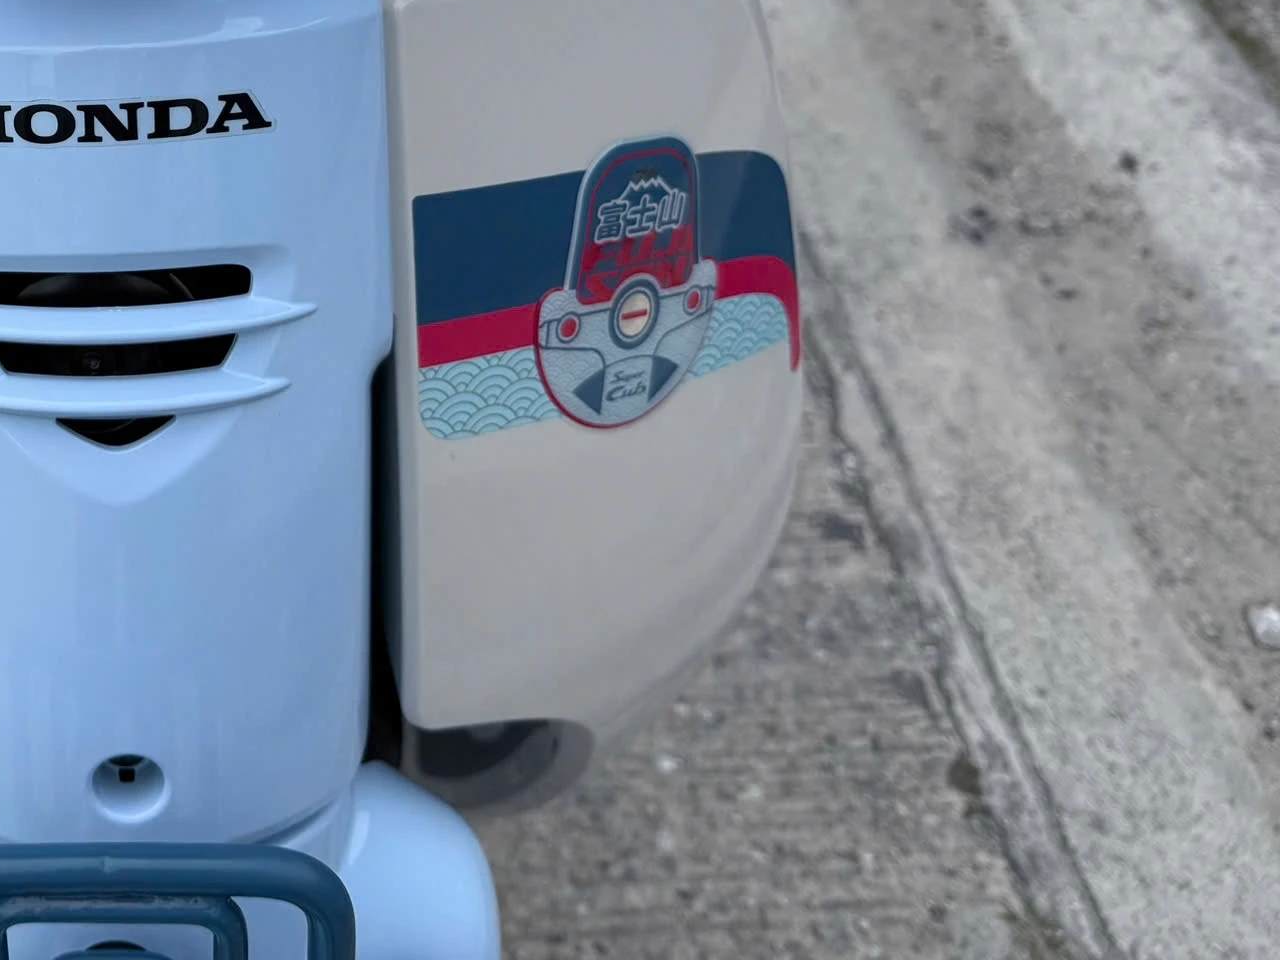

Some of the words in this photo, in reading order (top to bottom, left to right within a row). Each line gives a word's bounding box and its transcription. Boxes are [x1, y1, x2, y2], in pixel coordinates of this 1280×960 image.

[593, 188, 687, 244] 富士山
[606, 380, 647, 401] Cub
